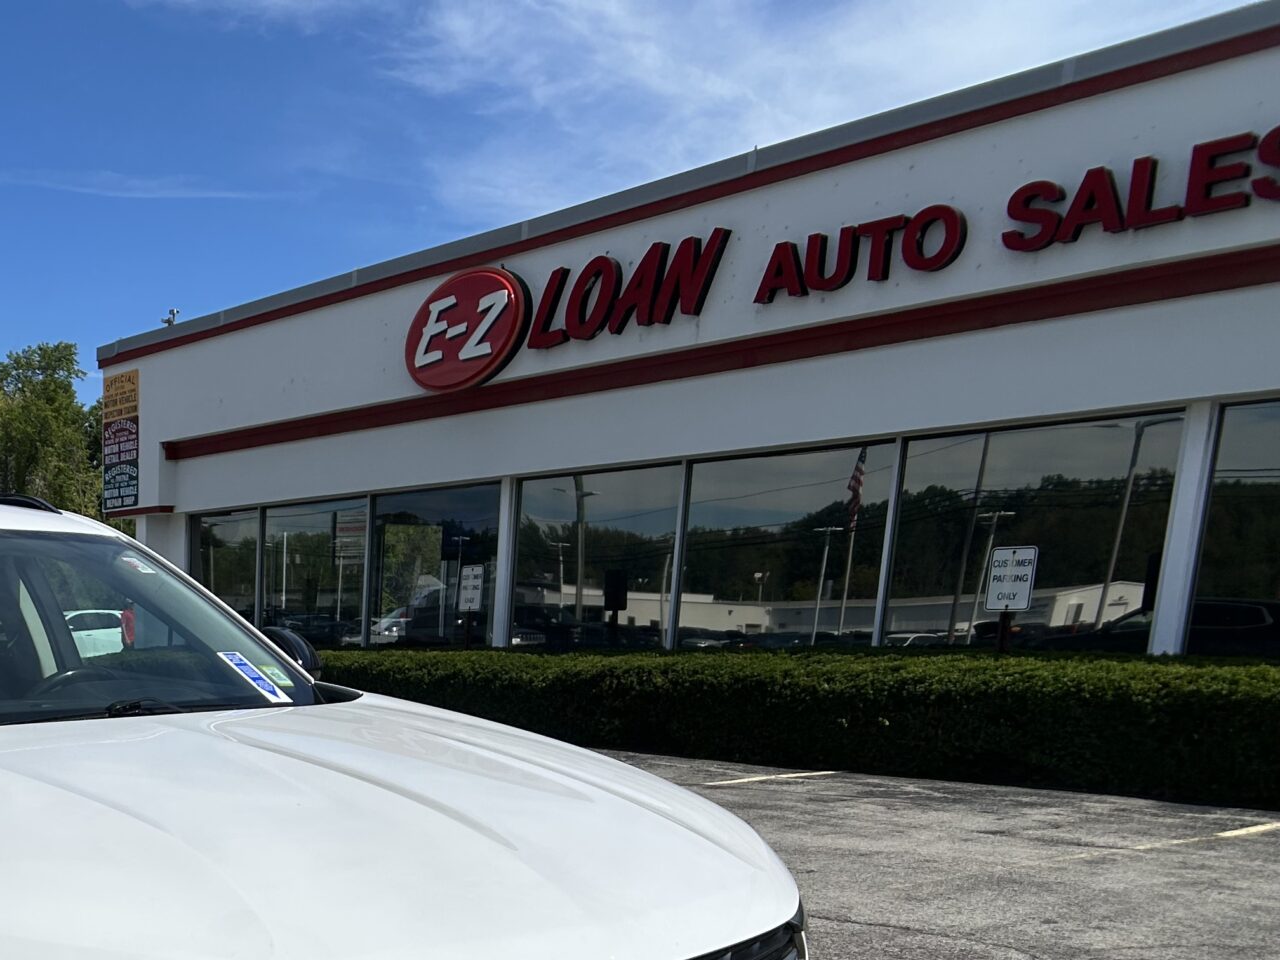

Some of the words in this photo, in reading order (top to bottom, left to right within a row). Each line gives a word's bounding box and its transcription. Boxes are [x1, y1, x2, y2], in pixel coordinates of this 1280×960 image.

[414, 289, 509, 369] E-Z
[527, 225, 732, 349] LOAN
[753, 204, 968, 304] AUTO
[105, 374, 136, 393] OFFICIAL
[119, 393, 137, 405] VEHICLE
[105, 419, 137, 438] REGISTERED
[120, 439, 137, 451] VEHICLE
[120, 449, 137, 461] DEALER
[105, 464, 137, 482] REGISTERED
[104, 488, 119, 498] MOTOR
[120, 485, 137, 496] VEHICLE
[106, 497, 122, 508] REPAIR
[123, 496, 135, 505] SHOP
[996, 592, 1018, 601] ONLY
